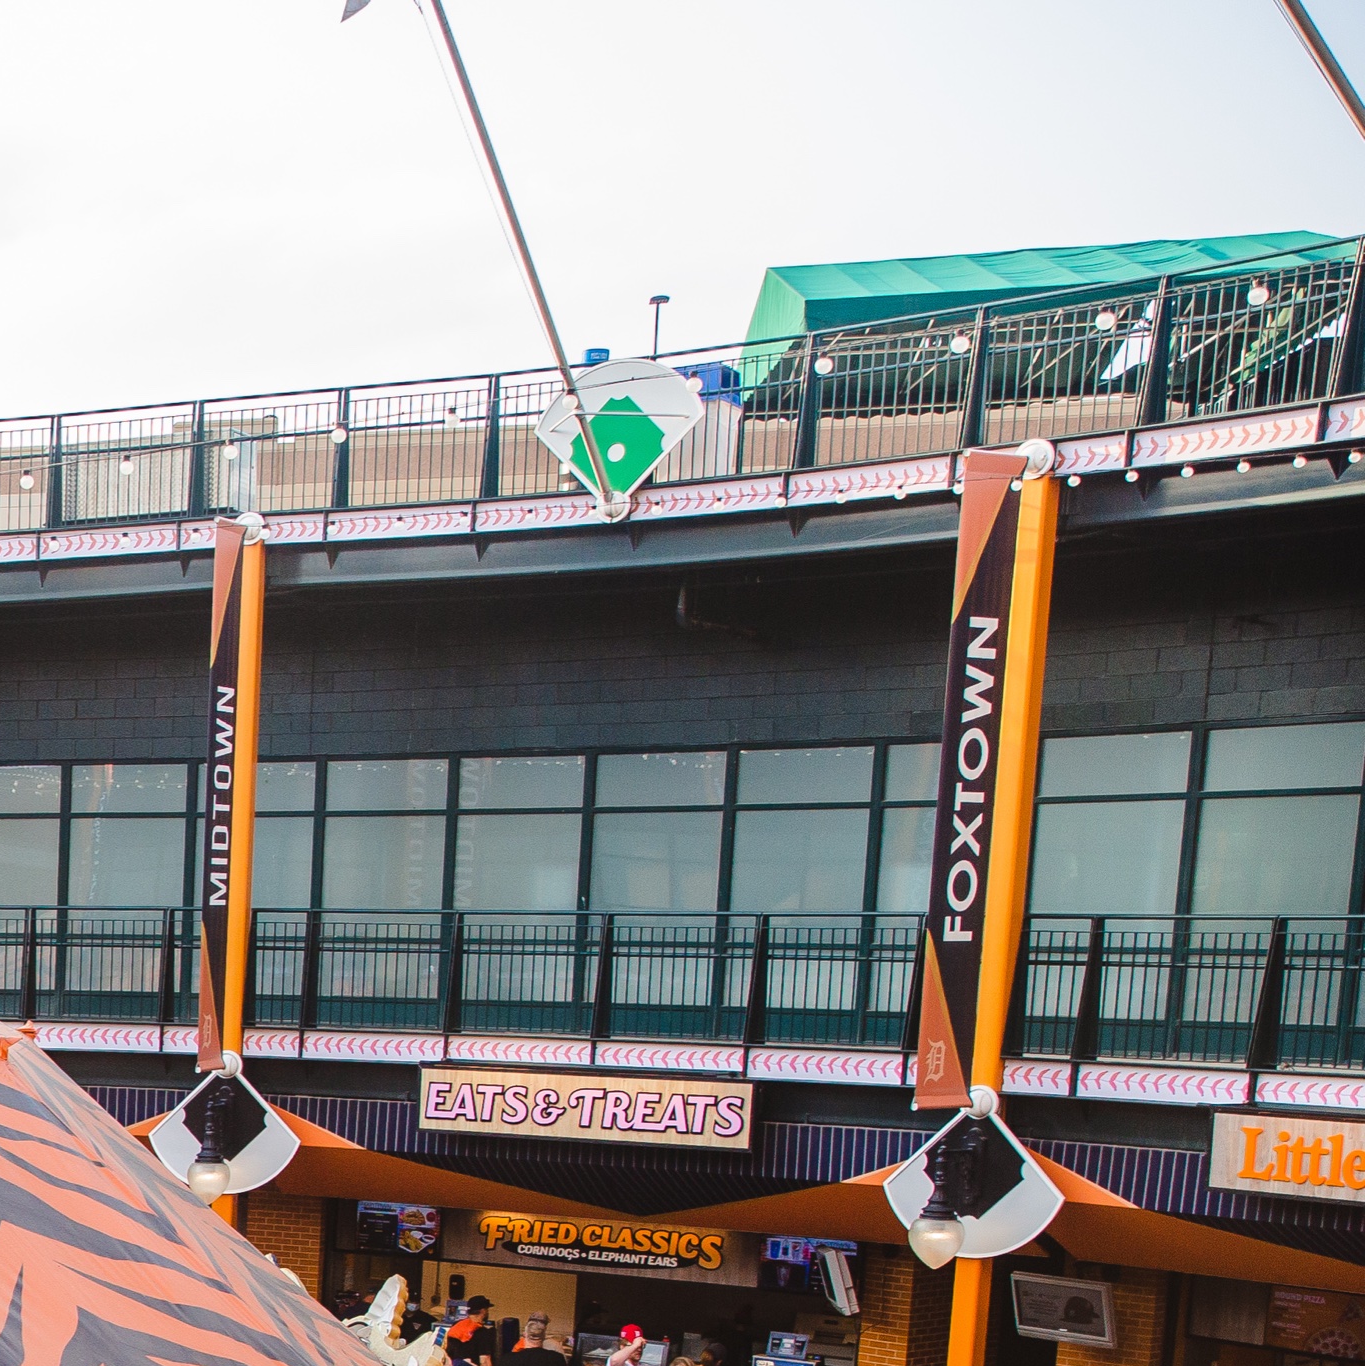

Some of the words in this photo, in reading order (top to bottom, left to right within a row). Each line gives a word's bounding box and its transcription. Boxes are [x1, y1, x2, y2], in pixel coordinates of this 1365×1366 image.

[208, 686, 237, 907] MIDTOWN
[942, 616, 1000, 942] FOXTOWN
[924, 1037, 946, 1086] D
[425, 1082, 528, 1124] EATS
[569, 1088, 744, 1137] TREATS
[1238, 1127, 1365, 1190] Little
[479, 1216, 577, 1250] FRIED
[581, 1225, 725, 1270] CLASSICS
[588, 1250, 648, 1266] ELEPHANT
[647, 1254, 679, 1268] EARS
